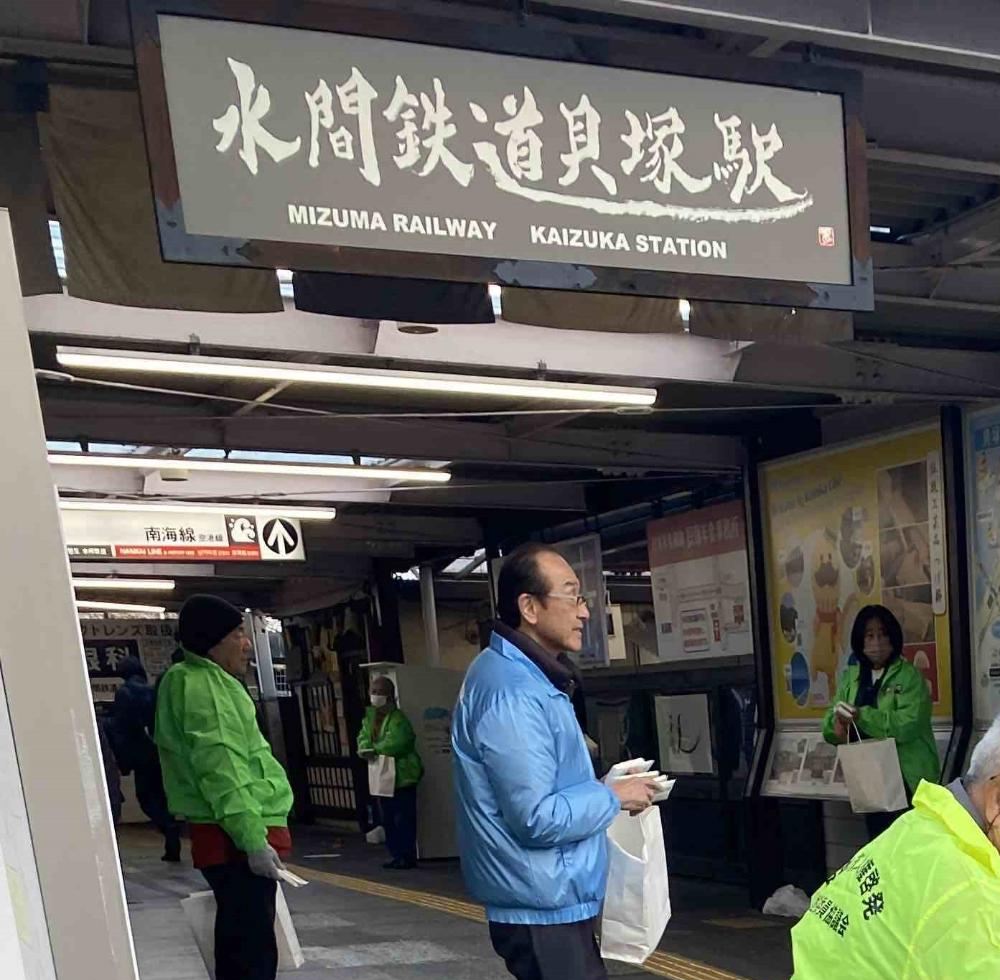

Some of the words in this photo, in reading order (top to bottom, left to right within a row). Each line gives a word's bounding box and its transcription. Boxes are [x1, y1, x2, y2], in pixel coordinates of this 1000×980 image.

[213, 57, 813, 222] 水間鉄道貝塚駅
[287, 203, 387, 231] MIZUMA
[393, 213, 497, 240] RAILWAY
[529, 224, 630, 252] KAIZUKA
[635, 234, 727, 260] STATION
[144, 526, 197, 543] 南海線
